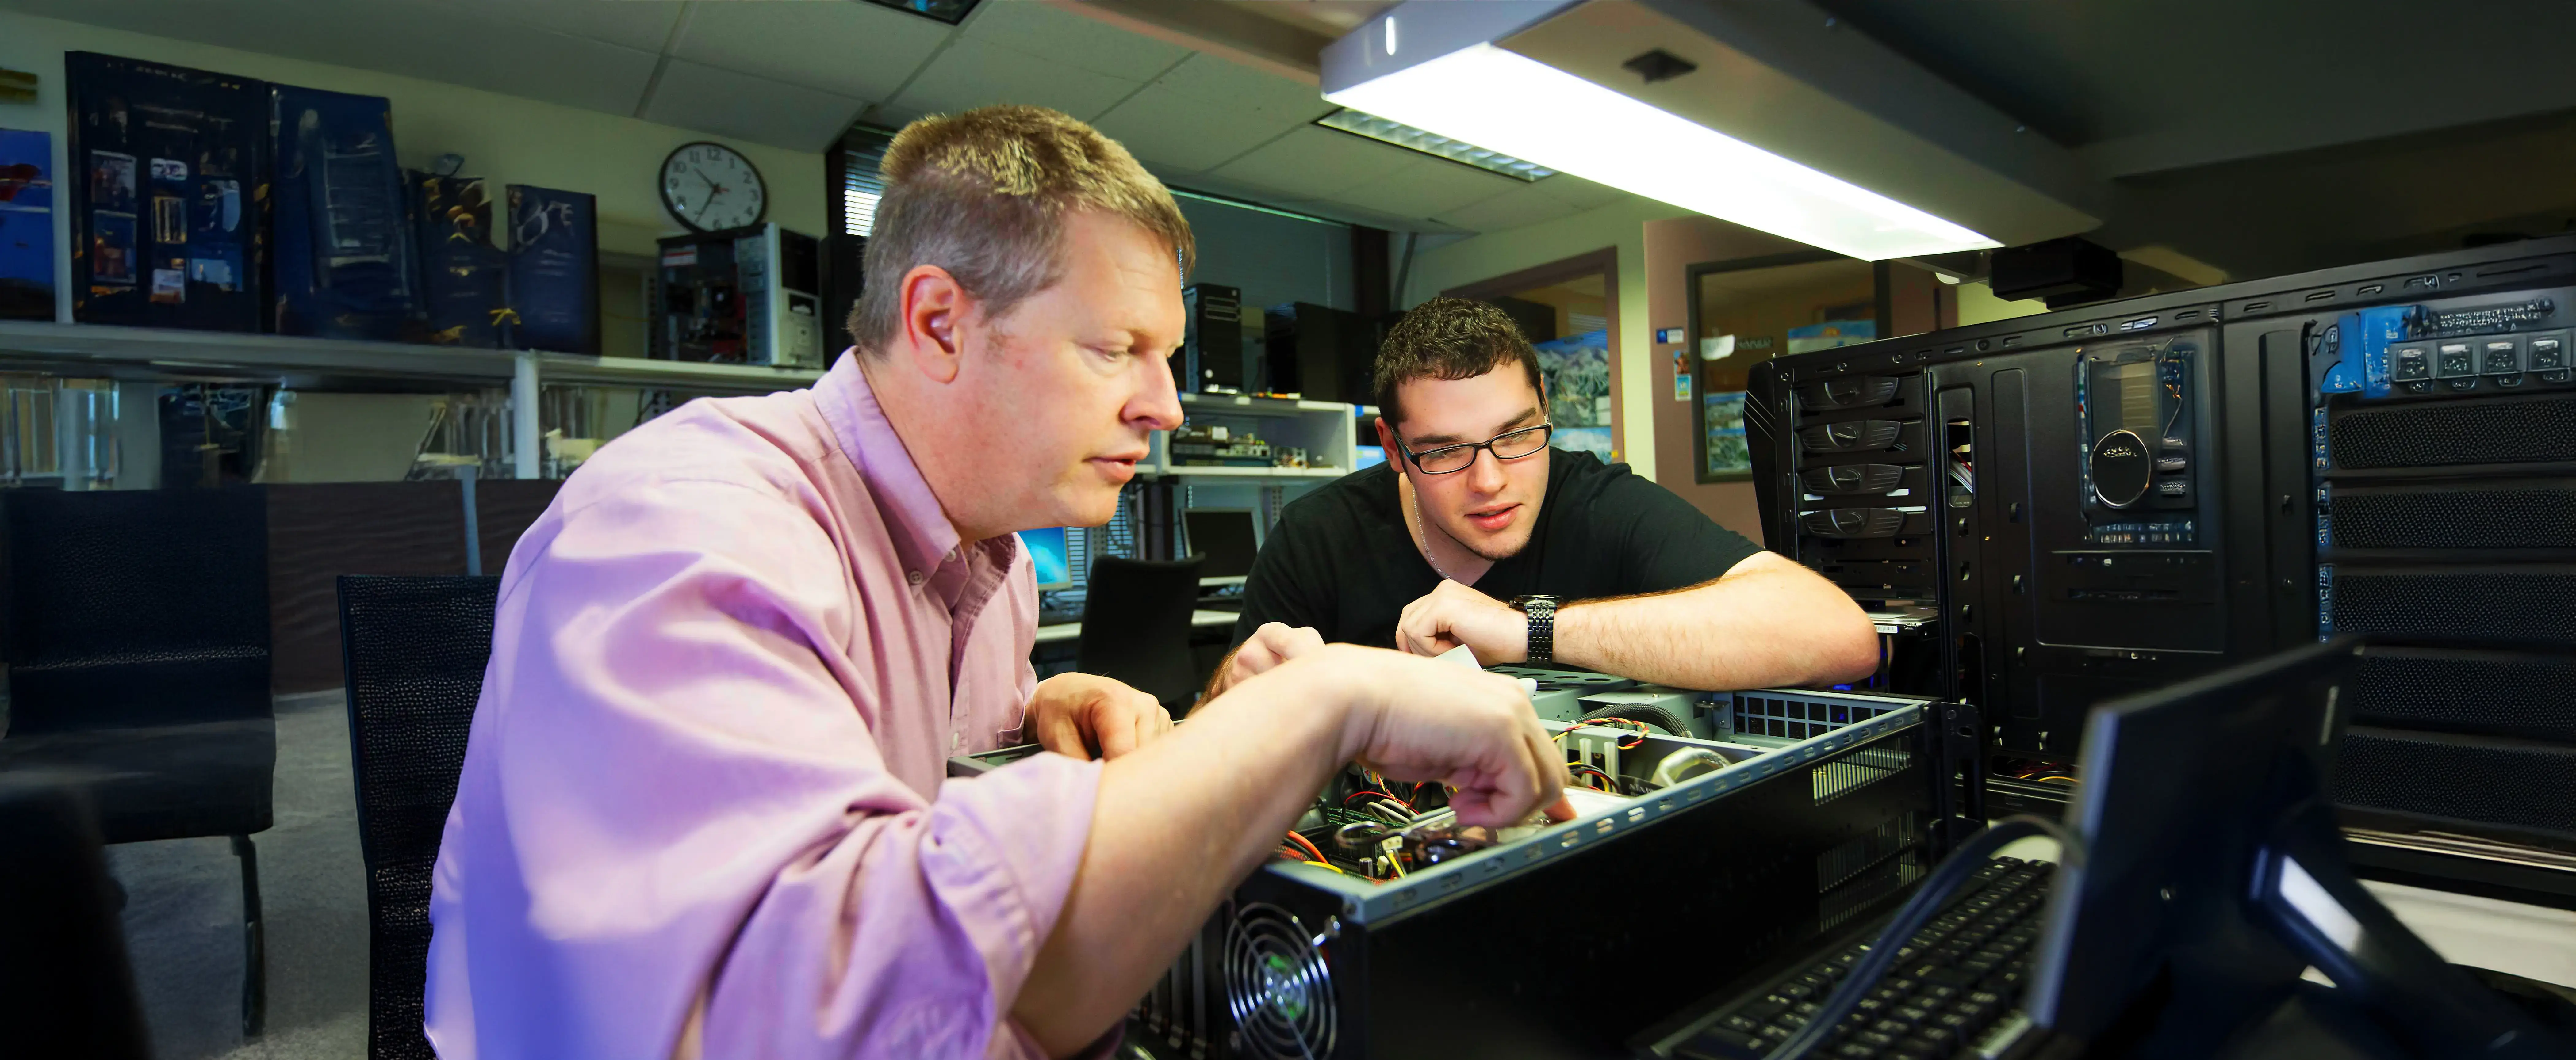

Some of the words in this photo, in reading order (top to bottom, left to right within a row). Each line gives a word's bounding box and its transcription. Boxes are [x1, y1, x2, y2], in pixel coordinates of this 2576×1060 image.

[689, 149, 700, 163] 11
[707, 147, 722, 161] 12
[673, 160, 687, 173] 10
[730, 158, 735, 169] 1
[743, 170, 753, 184] 2
[669, 178, 679, 190] 9
[749, 188, 759, 202] 3
[745, 206, 753, 217] 4
